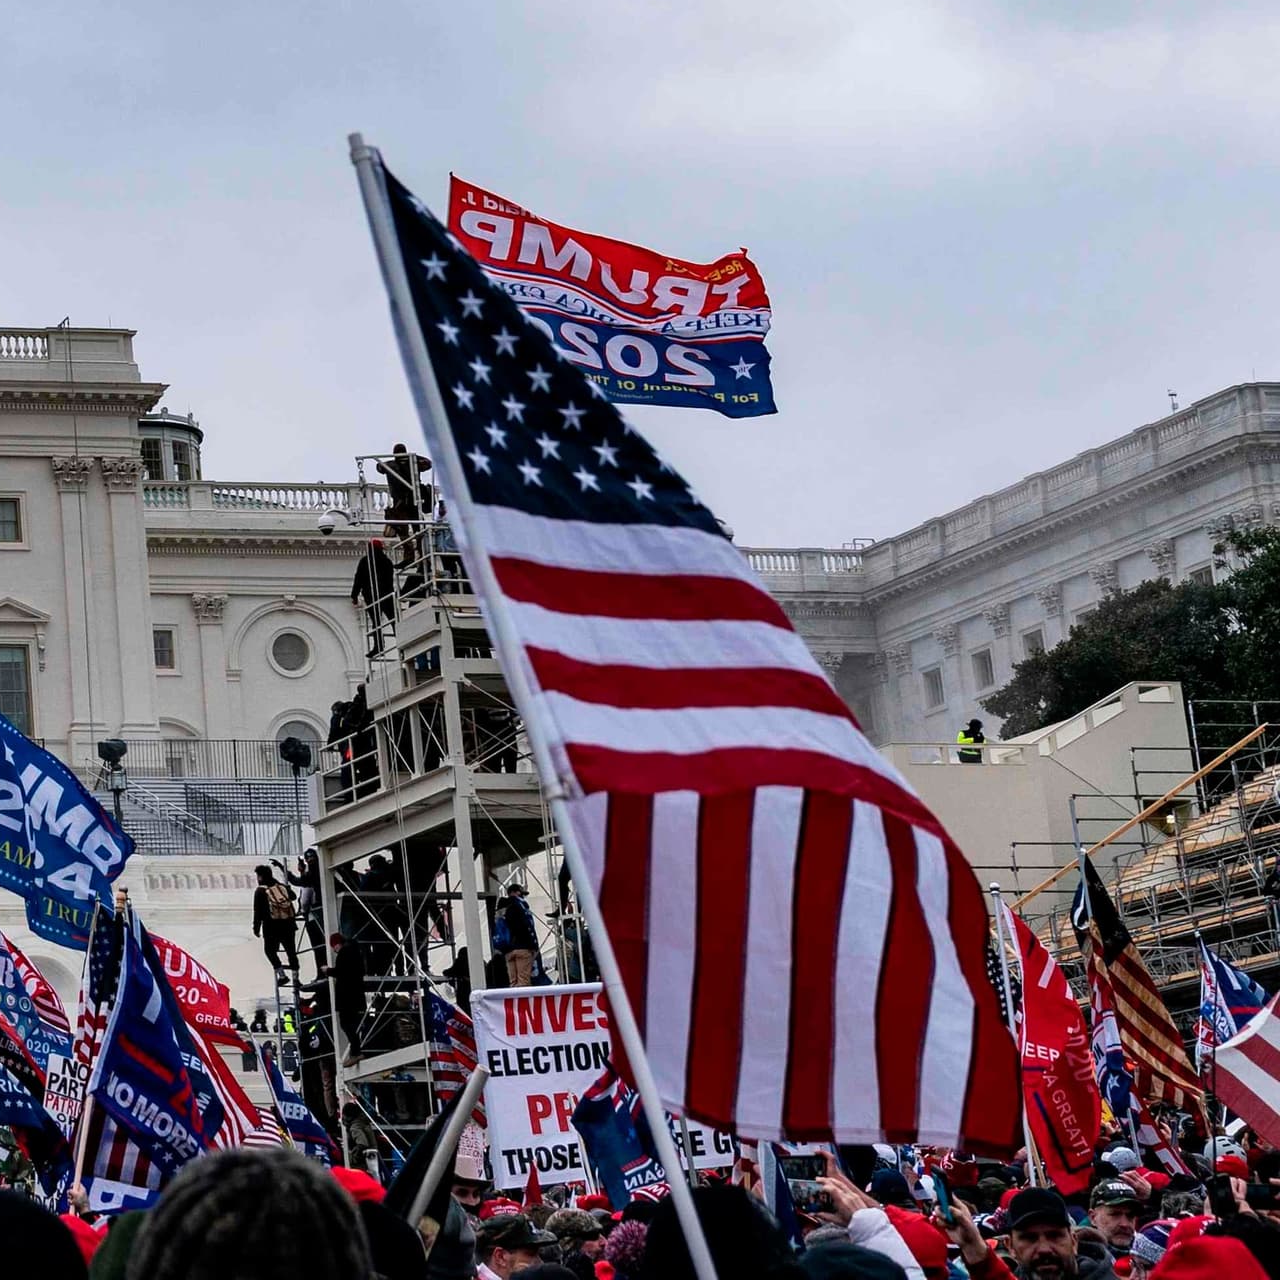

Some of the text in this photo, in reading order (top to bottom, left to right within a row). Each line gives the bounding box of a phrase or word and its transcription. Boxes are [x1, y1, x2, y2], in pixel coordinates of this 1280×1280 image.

[195, 1012, 230, 1028] GREA
[487, 1041, 610, 1077] ELECTION
[1024, 1041, 1061, 1063] EEP
[62, 1058, 90, 1081] NO
[130, 1093, 199, 1160] MORE
[502, 1144, 583, 1175] THOSE
